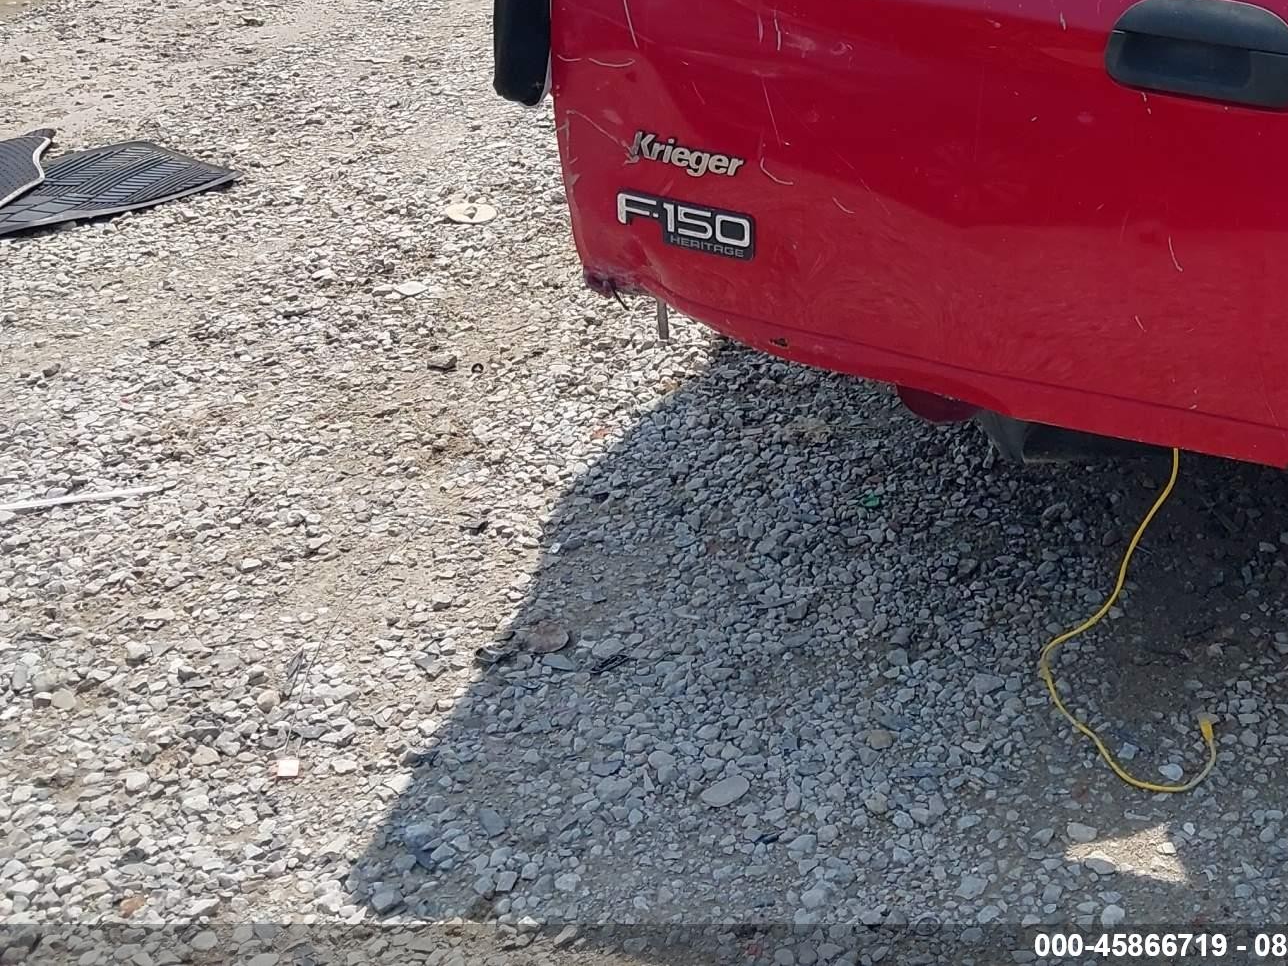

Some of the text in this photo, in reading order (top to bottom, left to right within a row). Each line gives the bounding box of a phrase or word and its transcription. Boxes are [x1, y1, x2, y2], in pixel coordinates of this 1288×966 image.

[632, 131, 744, 177] Krieger
[617, 192, 751, 248] F-150
[670, 235, 745, 258] HERITAGE
